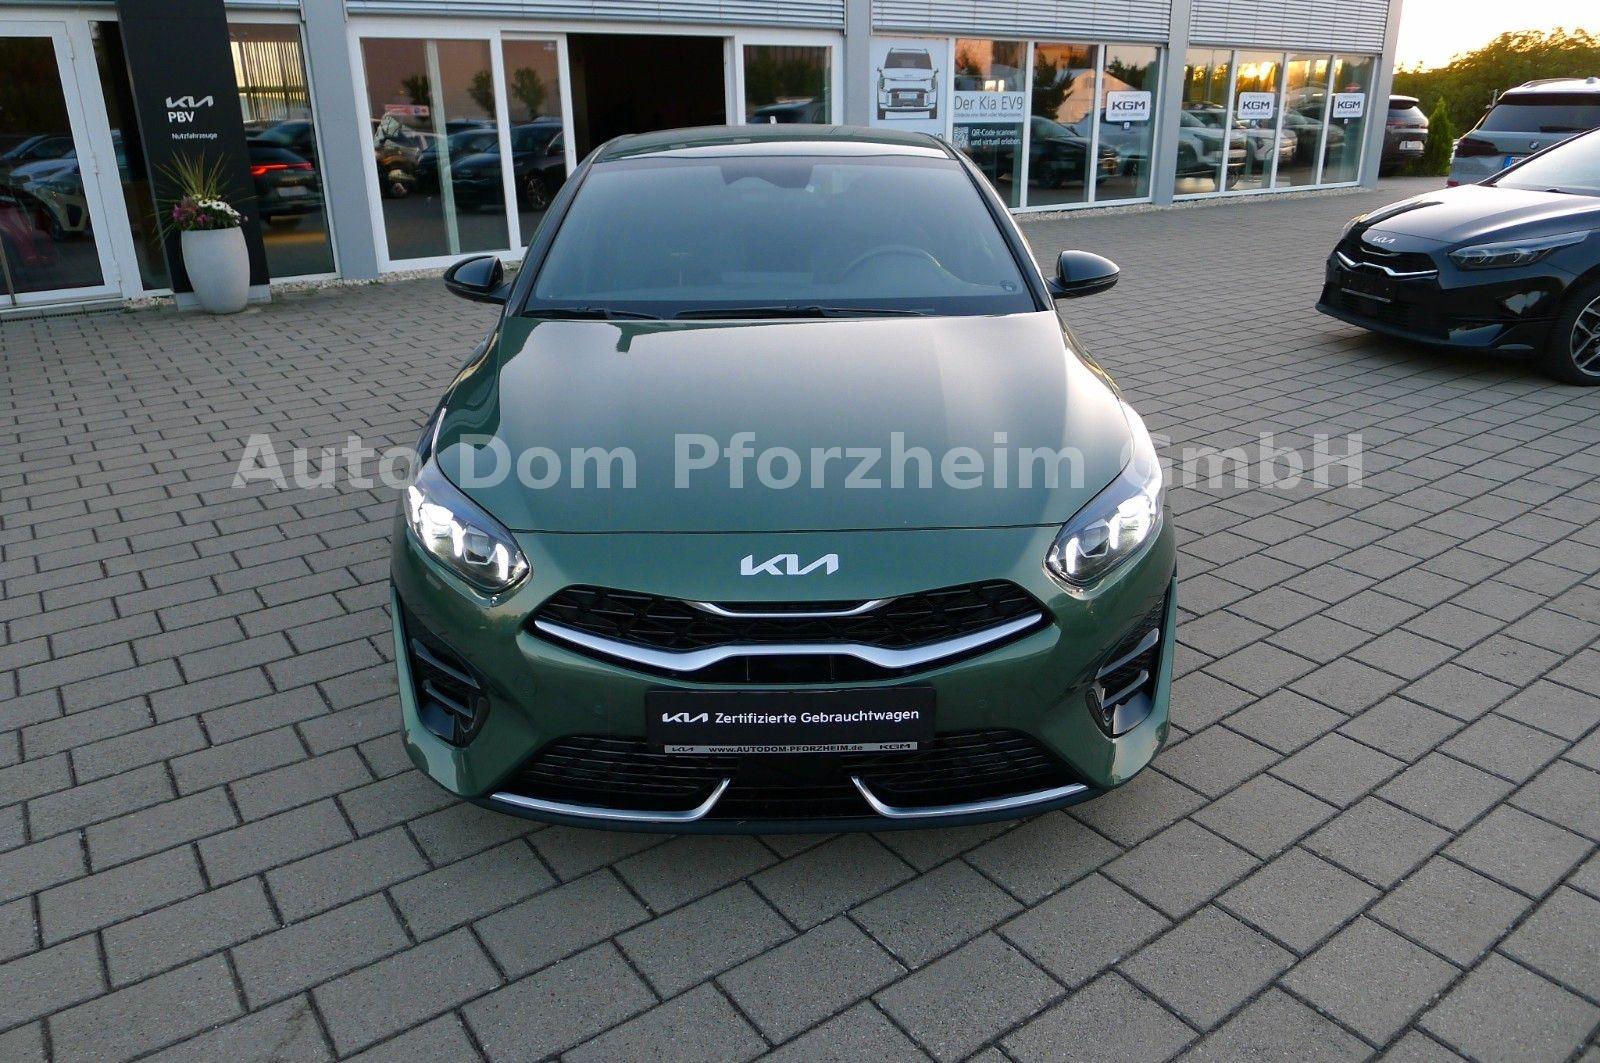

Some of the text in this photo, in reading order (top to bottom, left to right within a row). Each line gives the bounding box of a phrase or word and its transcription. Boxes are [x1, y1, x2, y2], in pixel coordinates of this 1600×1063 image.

[954, 95, 1023, 110] Der Kia EV9
[1112, 101, 1145, 110] KGM
[1243, 101, 1270, 110] KGM
[1337, 101, 1360, 109] KGM
[168, 112, 194, 122] PBV
[970, 138, 981, 146] und
[715, 712, 797, 724] Zertifizierte
[801, 709, 919, 724] Gebrauchtwagen
